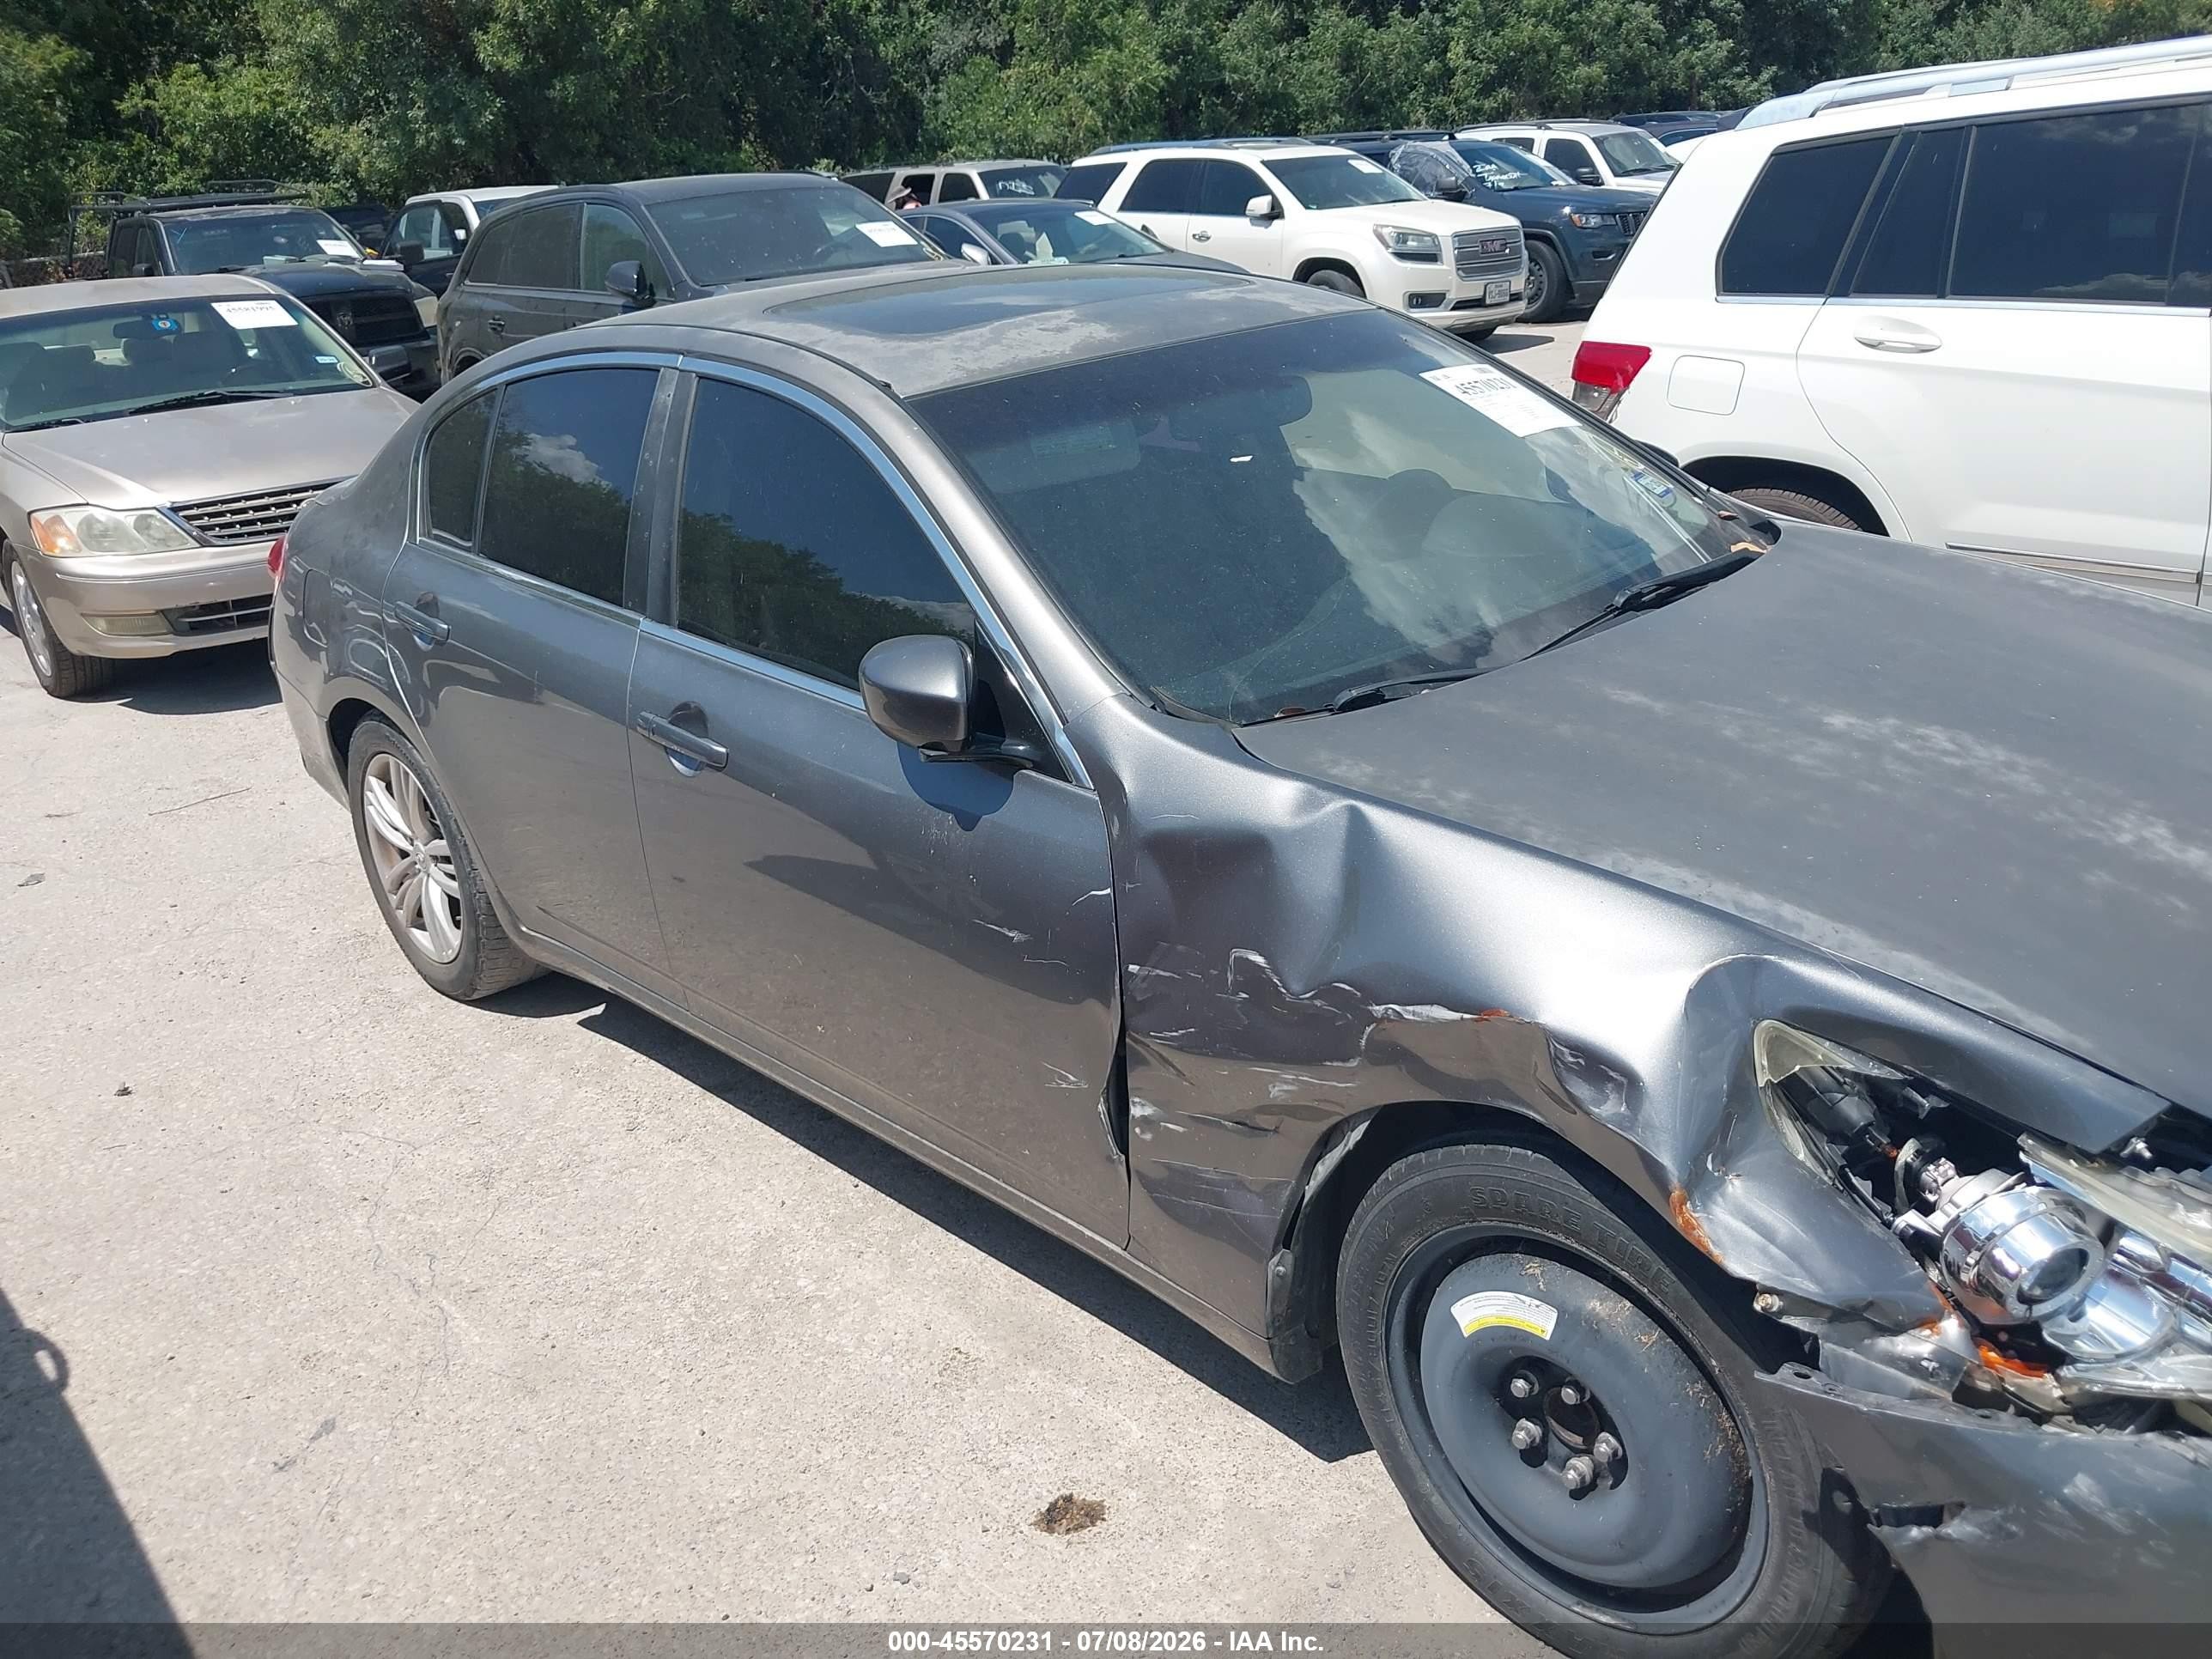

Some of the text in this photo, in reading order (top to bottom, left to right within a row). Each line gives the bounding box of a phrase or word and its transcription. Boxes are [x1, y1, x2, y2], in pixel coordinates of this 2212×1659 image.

[1455, 377, 1517, 396] 45570231
[1469, 1186, 1676, 1293] SPARE TIRE
